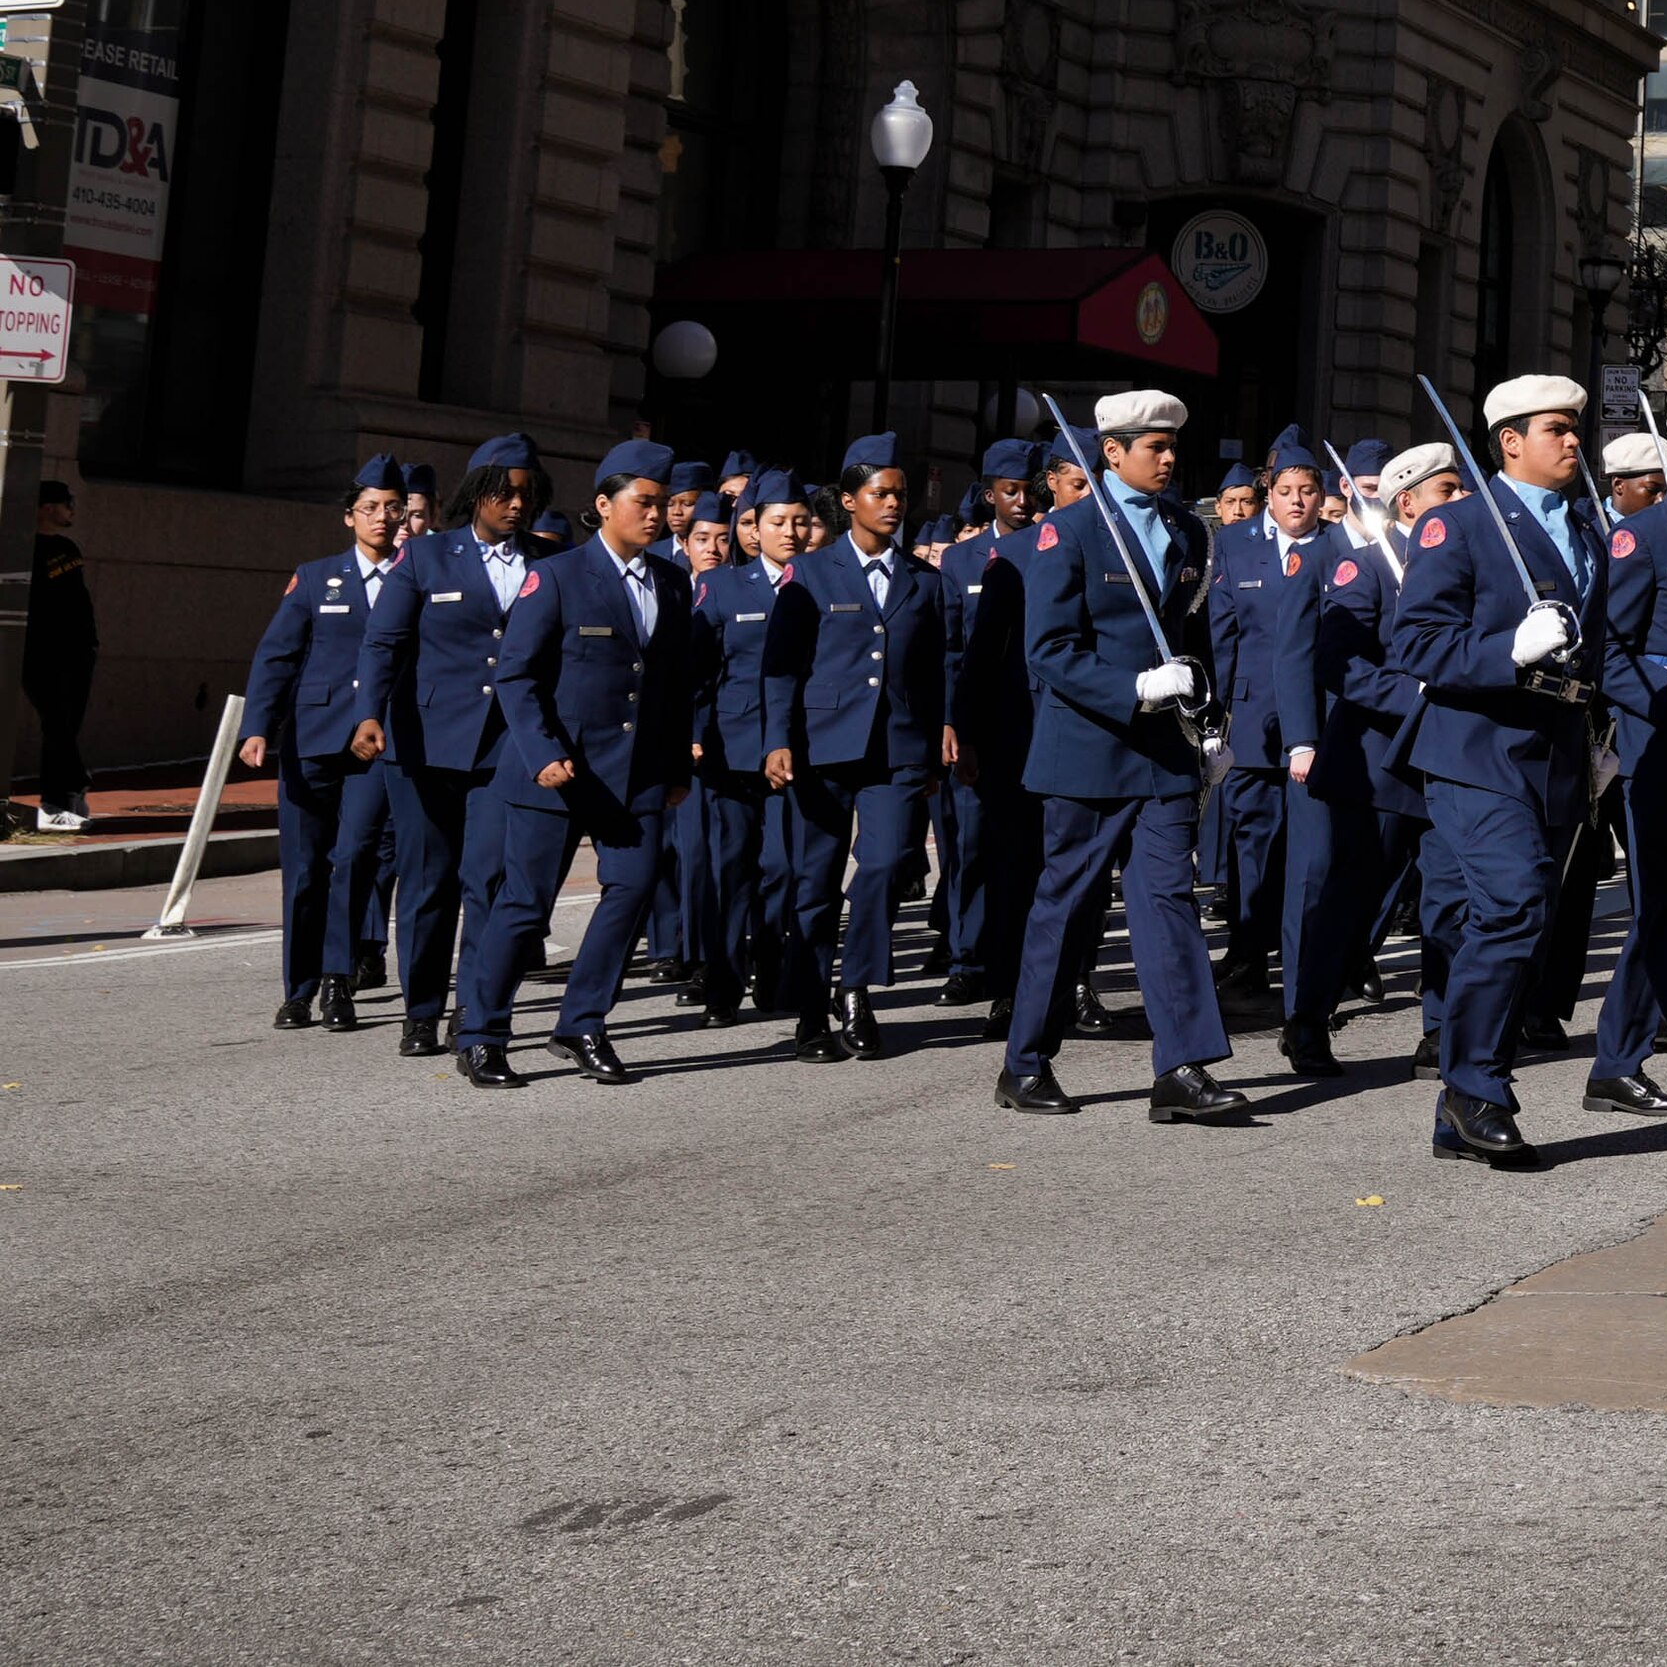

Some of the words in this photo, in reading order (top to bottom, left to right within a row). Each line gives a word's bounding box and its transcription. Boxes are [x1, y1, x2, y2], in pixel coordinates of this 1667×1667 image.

[129, 47, 180, 81] RETAIL
[1195, 230, 1249, 262] B&O
[10, 275, 45, 297] NO
[0, 311, 61, 334] TOPPING
[1605, 385, 1637, 393] PARKING
[1614, 376, 1628, 384] NO
